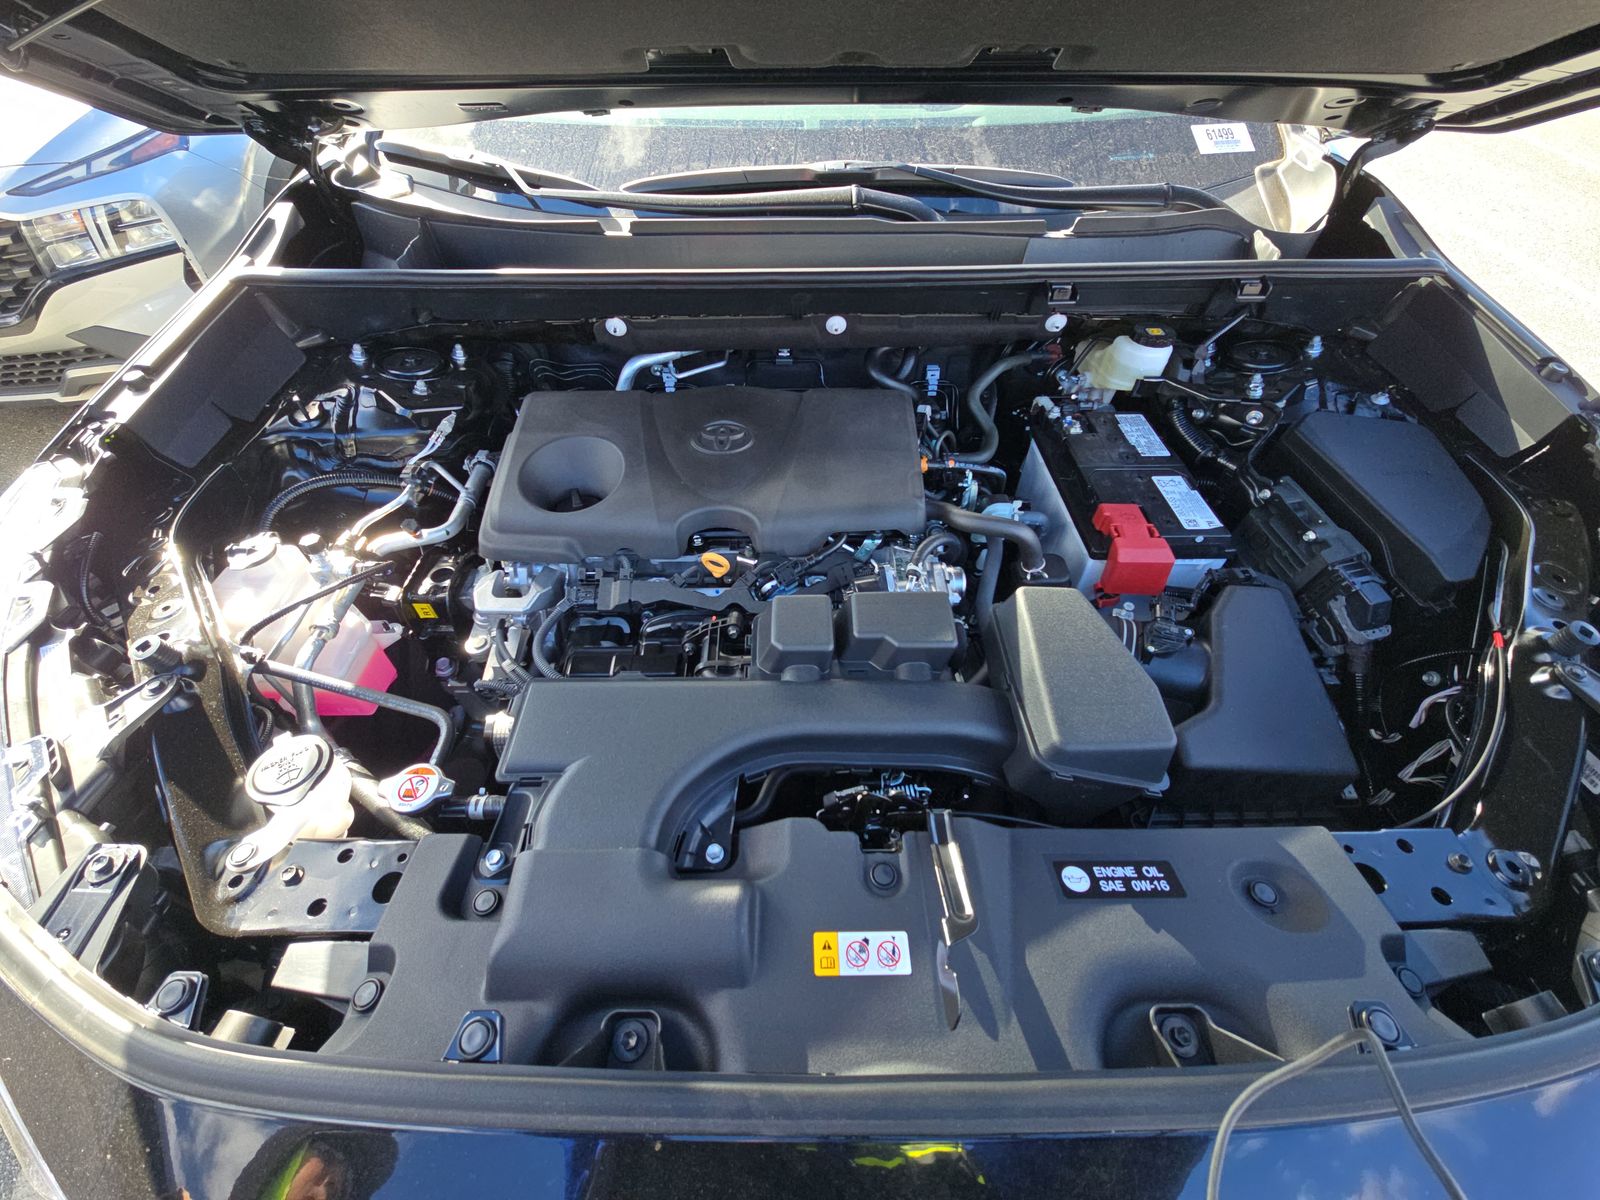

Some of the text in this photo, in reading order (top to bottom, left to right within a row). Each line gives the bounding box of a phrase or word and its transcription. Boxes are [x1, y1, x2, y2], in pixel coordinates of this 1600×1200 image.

[1205, 127, 1235, 140] 61499
[1092, 866, 1164, 878] ENGINE OIL
[1099, 880, 1170, 892] SAE 0W-16
